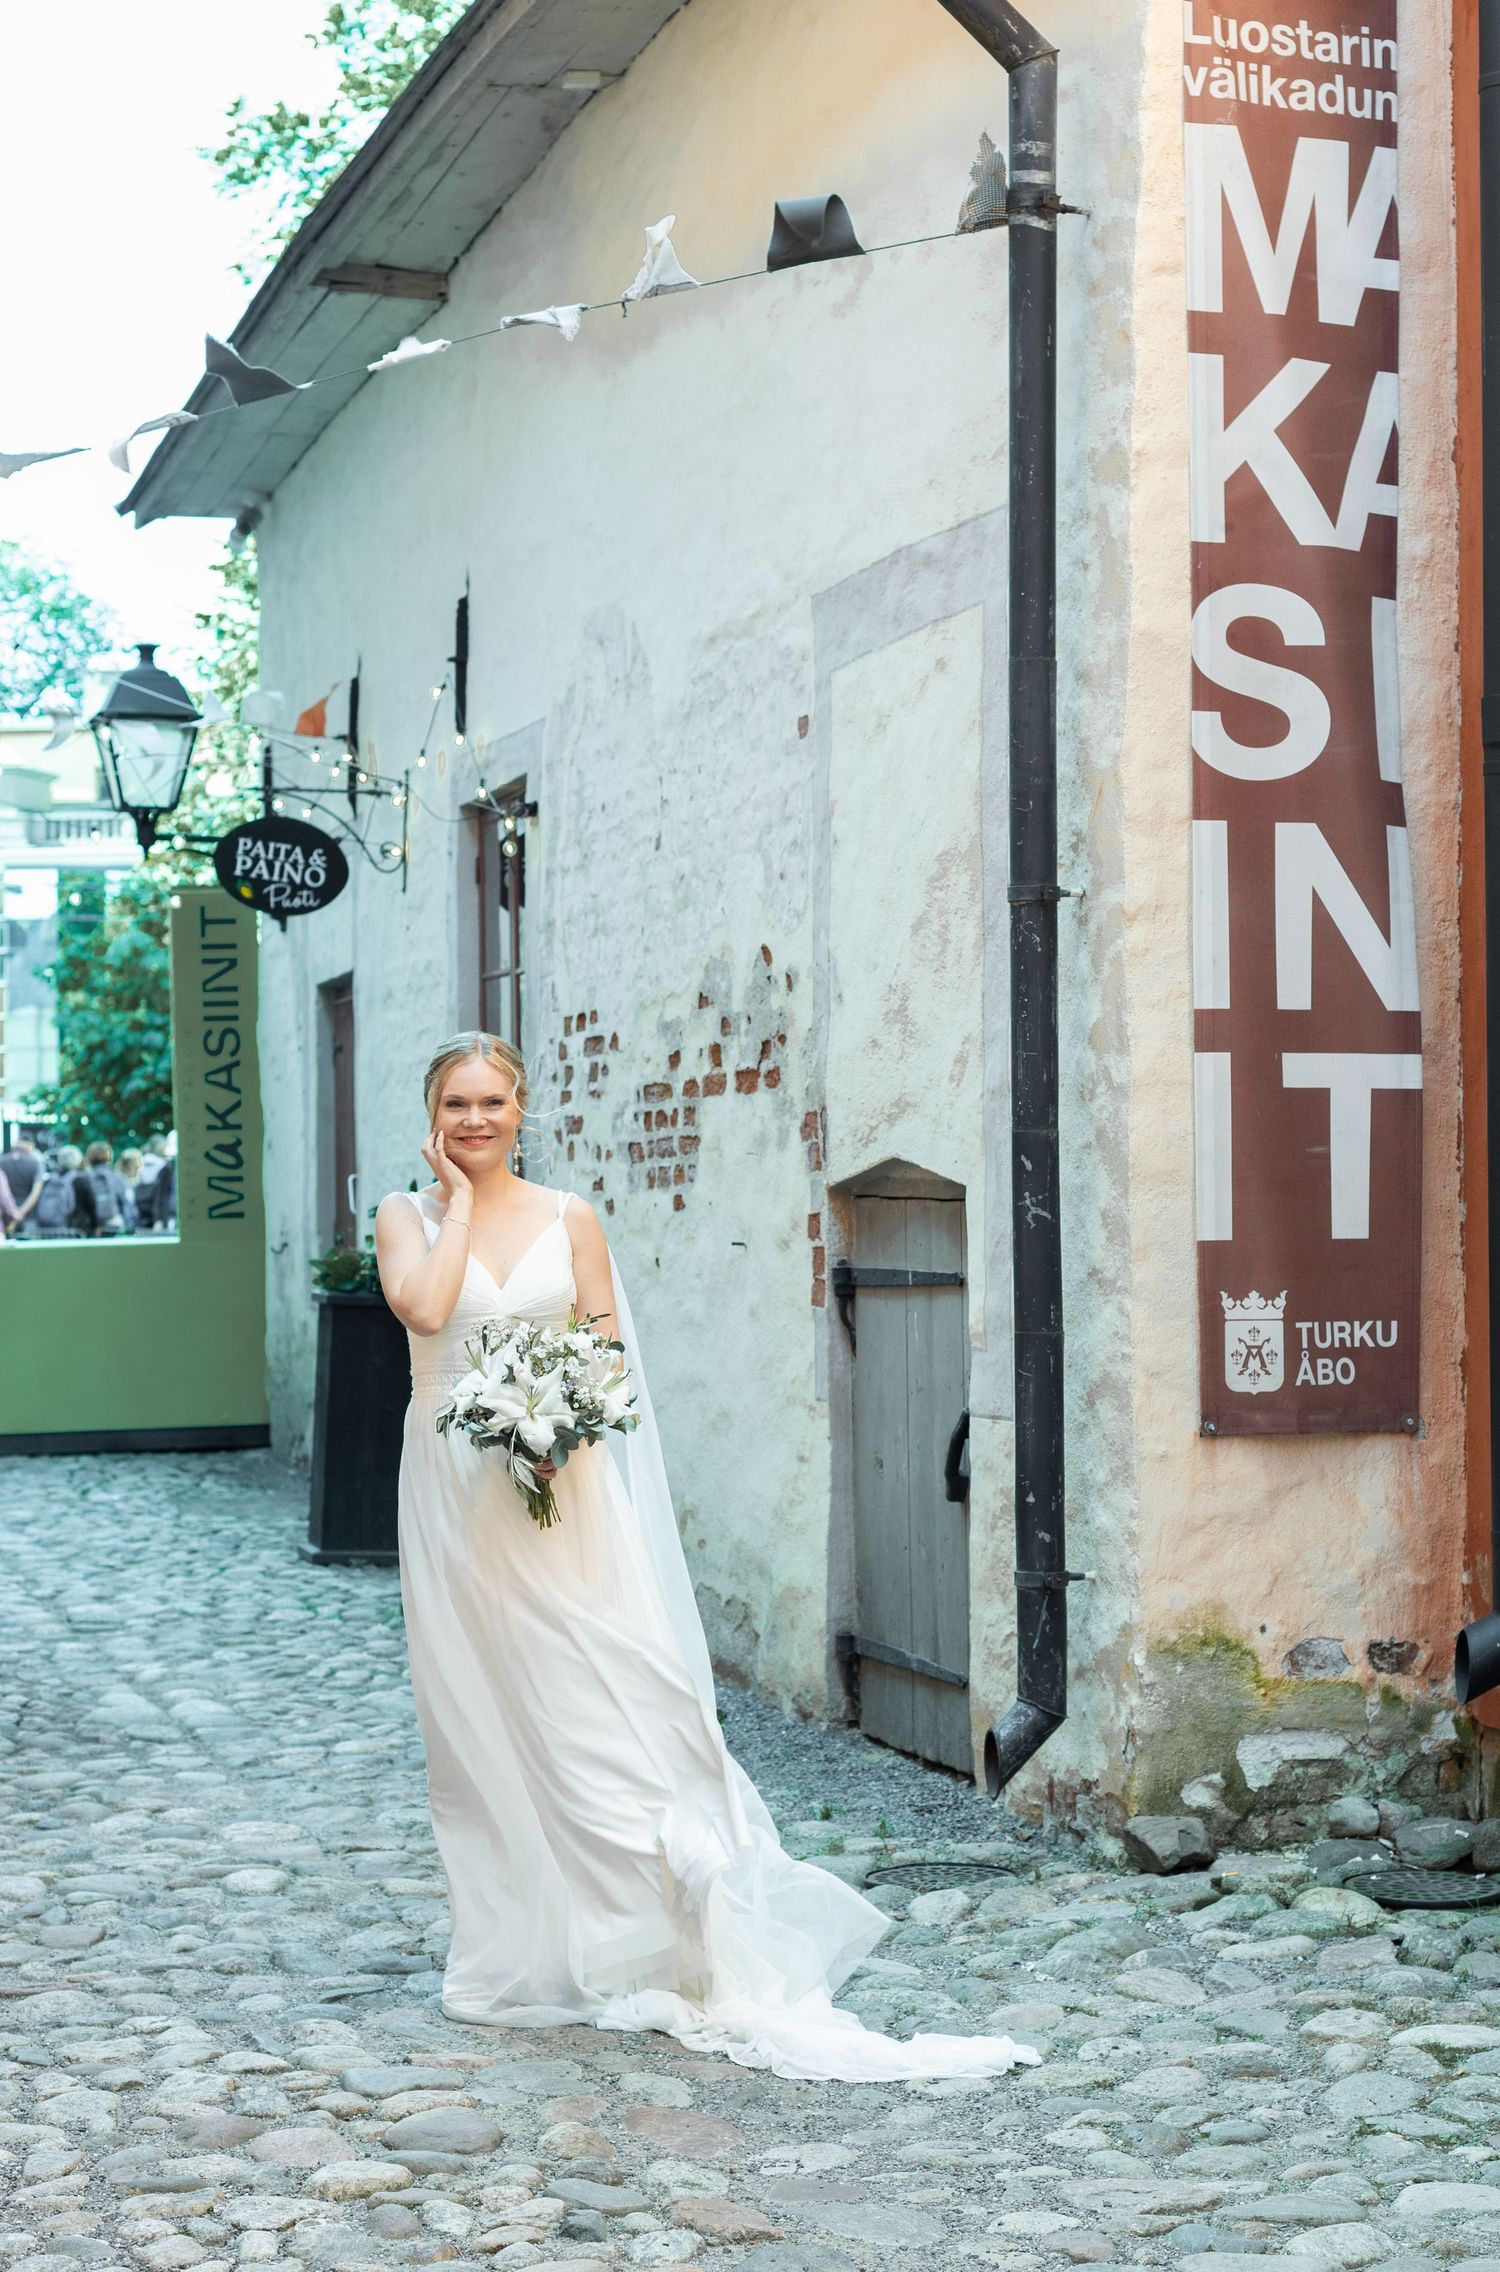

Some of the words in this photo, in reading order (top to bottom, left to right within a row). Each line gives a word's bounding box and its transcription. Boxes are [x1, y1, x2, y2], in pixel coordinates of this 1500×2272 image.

[1184, 1, 1398, 71] Luostarin
[1184, 56, 1398, 122] välikadun
[235, 837, 305, 864] PAITA
[308, 848, 328, 869] &
[233, 855, 327, 888] PAINO
[262, 883, 321, 909] Puoti
[1295, 1320, 1398, 1349] TURKU
[1295, 1350, 1356, 1386] ÅBO
